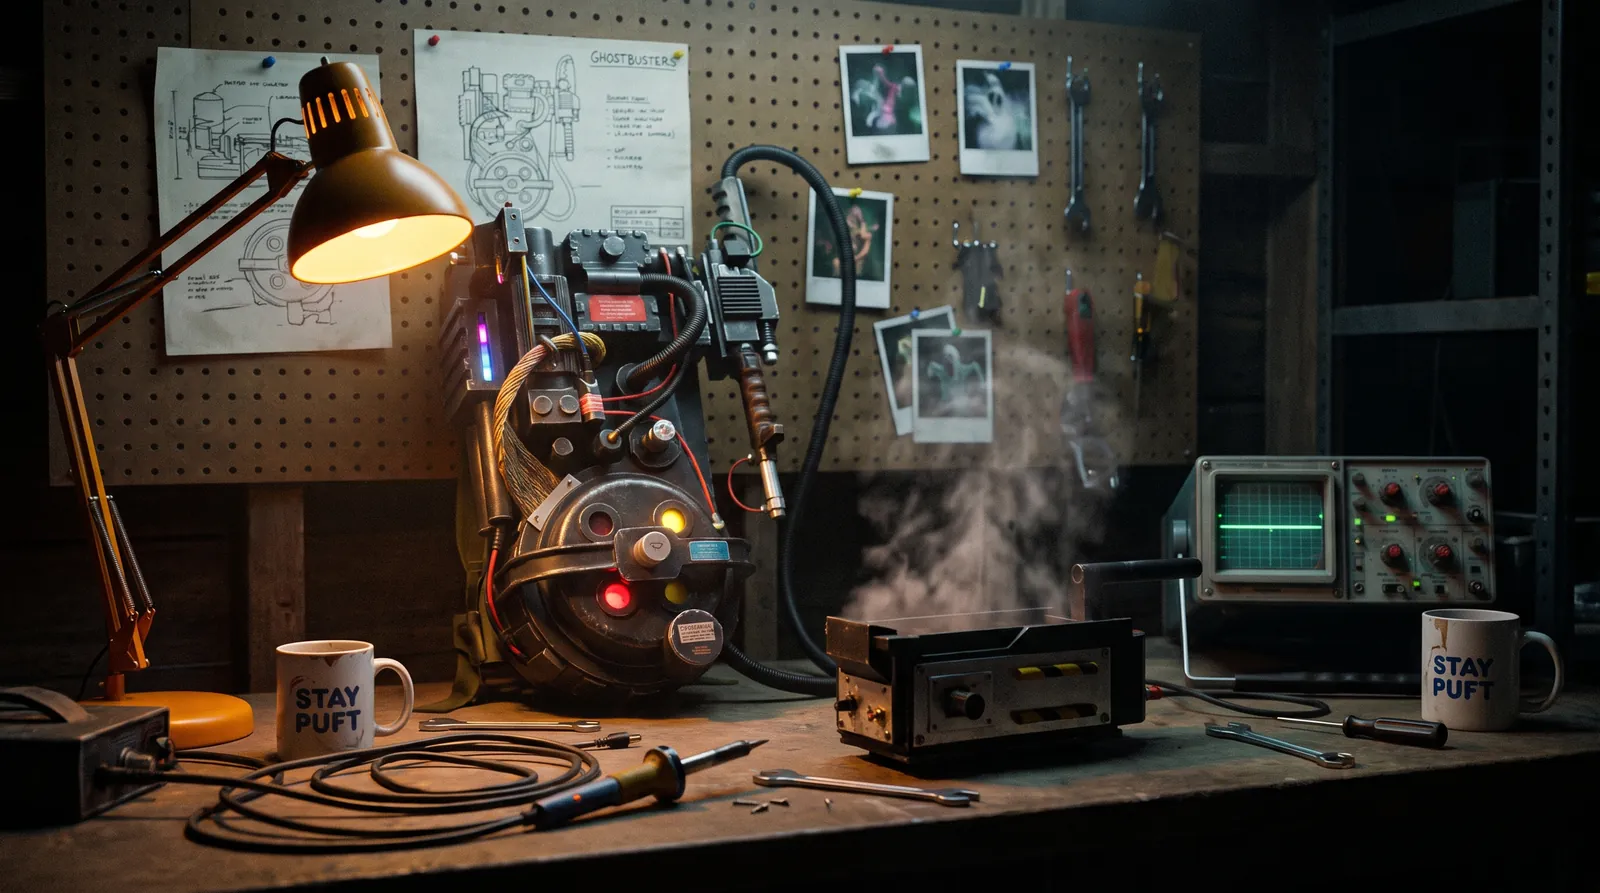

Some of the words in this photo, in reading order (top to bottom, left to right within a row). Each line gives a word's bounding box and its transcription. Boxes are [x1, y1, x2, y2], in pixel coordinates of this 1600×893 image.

[590, 50, 677, 67] GHOSTBUSTERS
[1433, 655, 1494, 677] STAY
[296, 686, 360, 709] STAY
[1433, 678, 1494, 700] PUFT
[296, 710, 361, 733] PUFT
